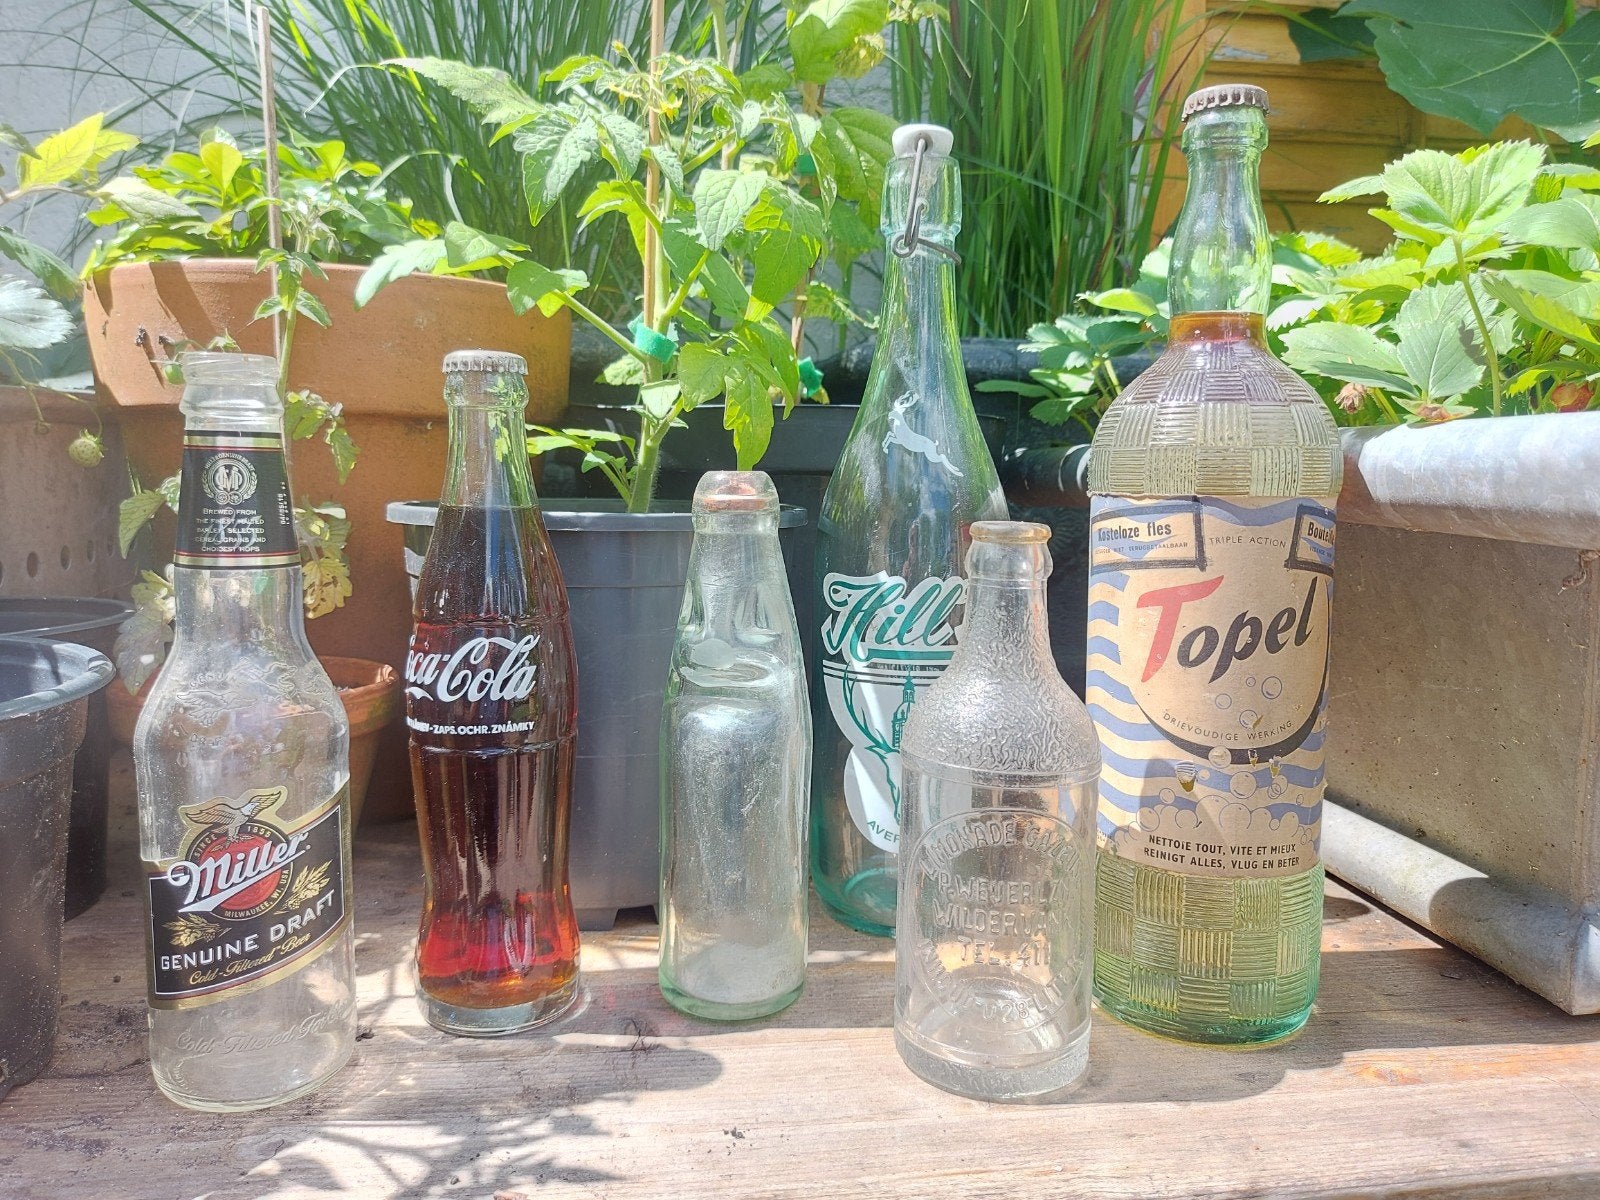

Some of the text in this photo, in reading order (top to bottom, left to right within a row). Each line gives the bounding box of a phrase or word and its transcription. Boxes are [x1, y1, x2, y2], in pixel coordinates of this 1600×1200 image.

[1147, 521, 1172, 537] fles
[1209, 536, 1286, 549] TRIPLE ACTION
[1135, 574, 1318, 685] Topel
[1163, 712, 1294, 742] DRIEVOUDIGE WERKING
[194, 833, 218, 858] SINCE
[1143, 846, 1300, 870] REINIGT ALLES, VLUG EN BETER
[1195, 842, 1226, 856] TOUT,
[1230, 845, 1253, 856] VITE
[1256, 846, 1268, 856] ET
[1270, 843, 1297, 854] MIEUX
[167, 831, 311, 912] Miller
[224, 900, 274, 919] MILWAUKEE,
[279, 869, 290, 884] USA
[161, 889, 335, 970] GENUINE DRAFT
[280, 932, 312, 955] Beer
